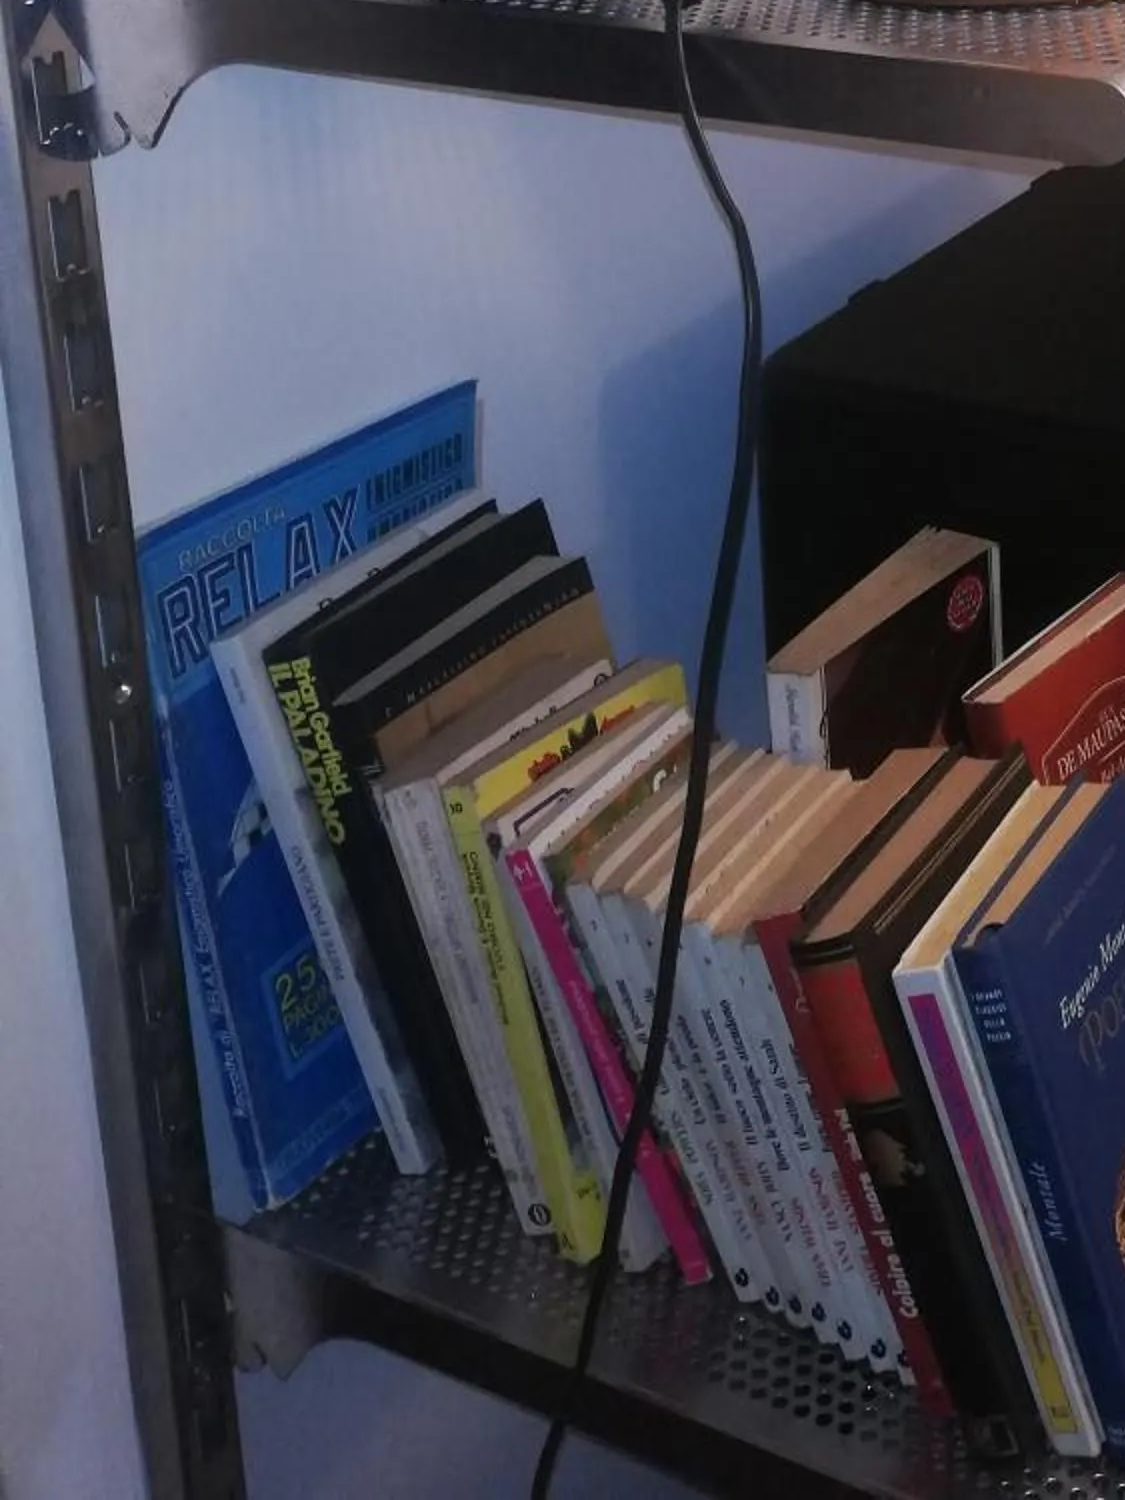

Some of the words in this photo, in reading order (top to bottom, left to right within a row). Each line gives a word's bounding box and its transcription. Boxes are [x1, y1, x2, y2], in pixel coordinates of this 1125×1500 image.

[177, 503, 286, 573] RACCOLTA
[157, 483, 361, 679] RELAX
[268, 662, 293, 688] IL
[291, 657, 321, 711] Brian
[310, 711, 353, 796] Garfield
[278, 689, 346, 846] PALADINO
[1057, 751, 1077, 780] DE
[1059, 964, 1101, 1028] Eugenio
[856, 1171, 884, 1223] cuore
[874, 1227, 893, 1248] al
[882, 1249, 918, 1319] Colpire
